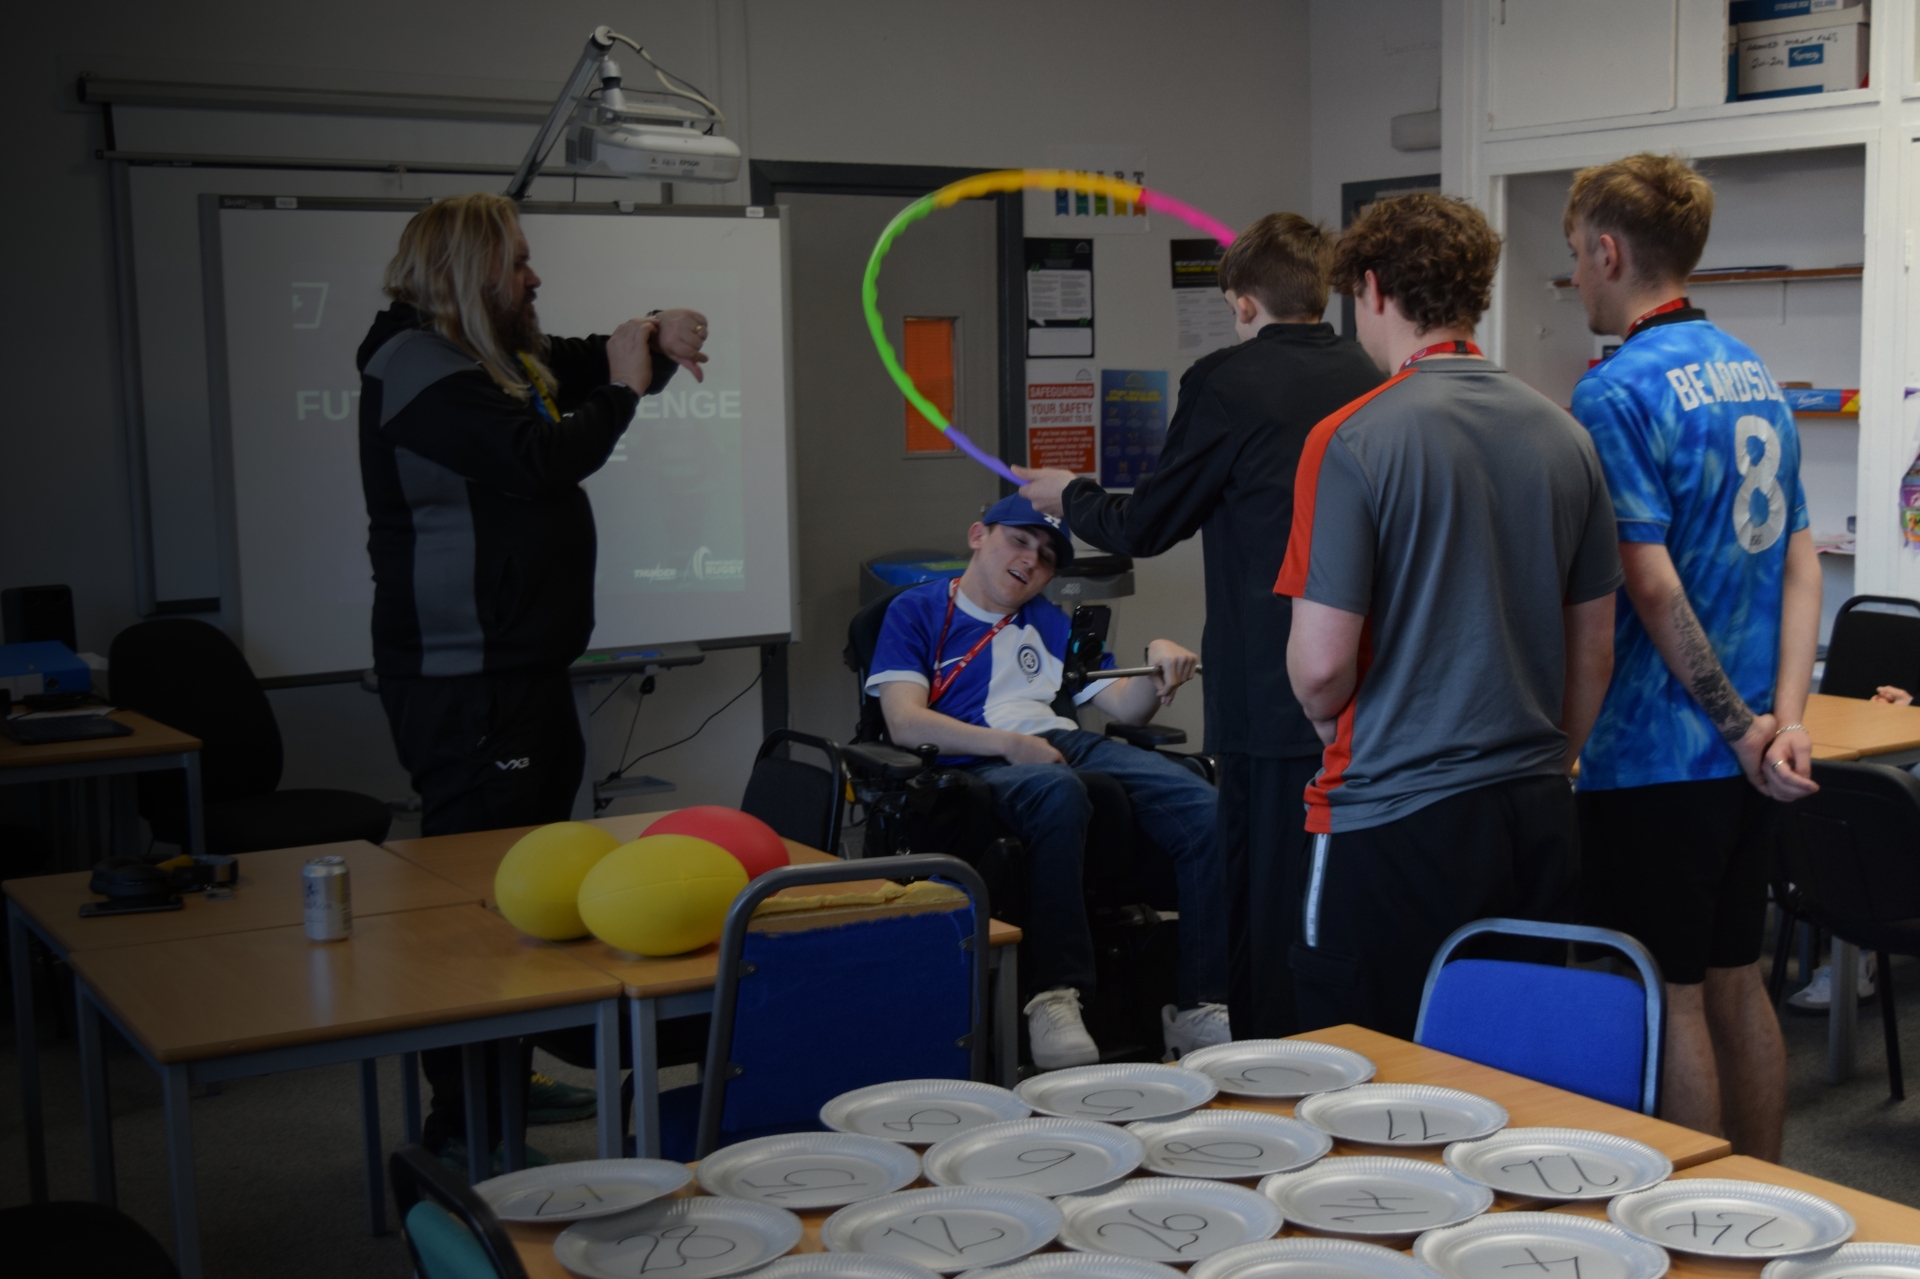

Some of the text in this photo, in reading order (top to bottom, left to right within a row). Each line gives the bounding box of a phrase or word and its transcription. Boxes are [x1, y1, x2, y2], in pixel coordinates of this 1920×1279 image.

[1030, 386, 1093, 398] SAFEGUARDING
[1030, 402, 1093, 414] YOUR SAFETY
[1031, 416, 1038, 424] IS
[1039, 416, 1074, 424] IMPORTANT
[1075, 415, 1083, 423] TO
[1733, 415, 1787, 554] 8
[705, 565, 744, 575] RUGBY
[494, 757, 530, 771] VX3
[1075, 1088, 1145, 1116] 5
[883, 1108, 962, 1133] 8
[1386, 1108, 1448, 1140] 11
[1161, 1140, 1264, 1169] 18
[742, 1167, 868, 1199] 15
[1501, 1153, 1619, 1195] 22
[524, 1182, 604, 1216] 21
[1320, 1189, 1429, 1222] 14
[884, 1215, 1005, 1257] 12
[1097, 1208, 1208, 1253] 26
[1666, 1210, 1785, 1249] 24
[616, 1225, 737, 1274] 28
